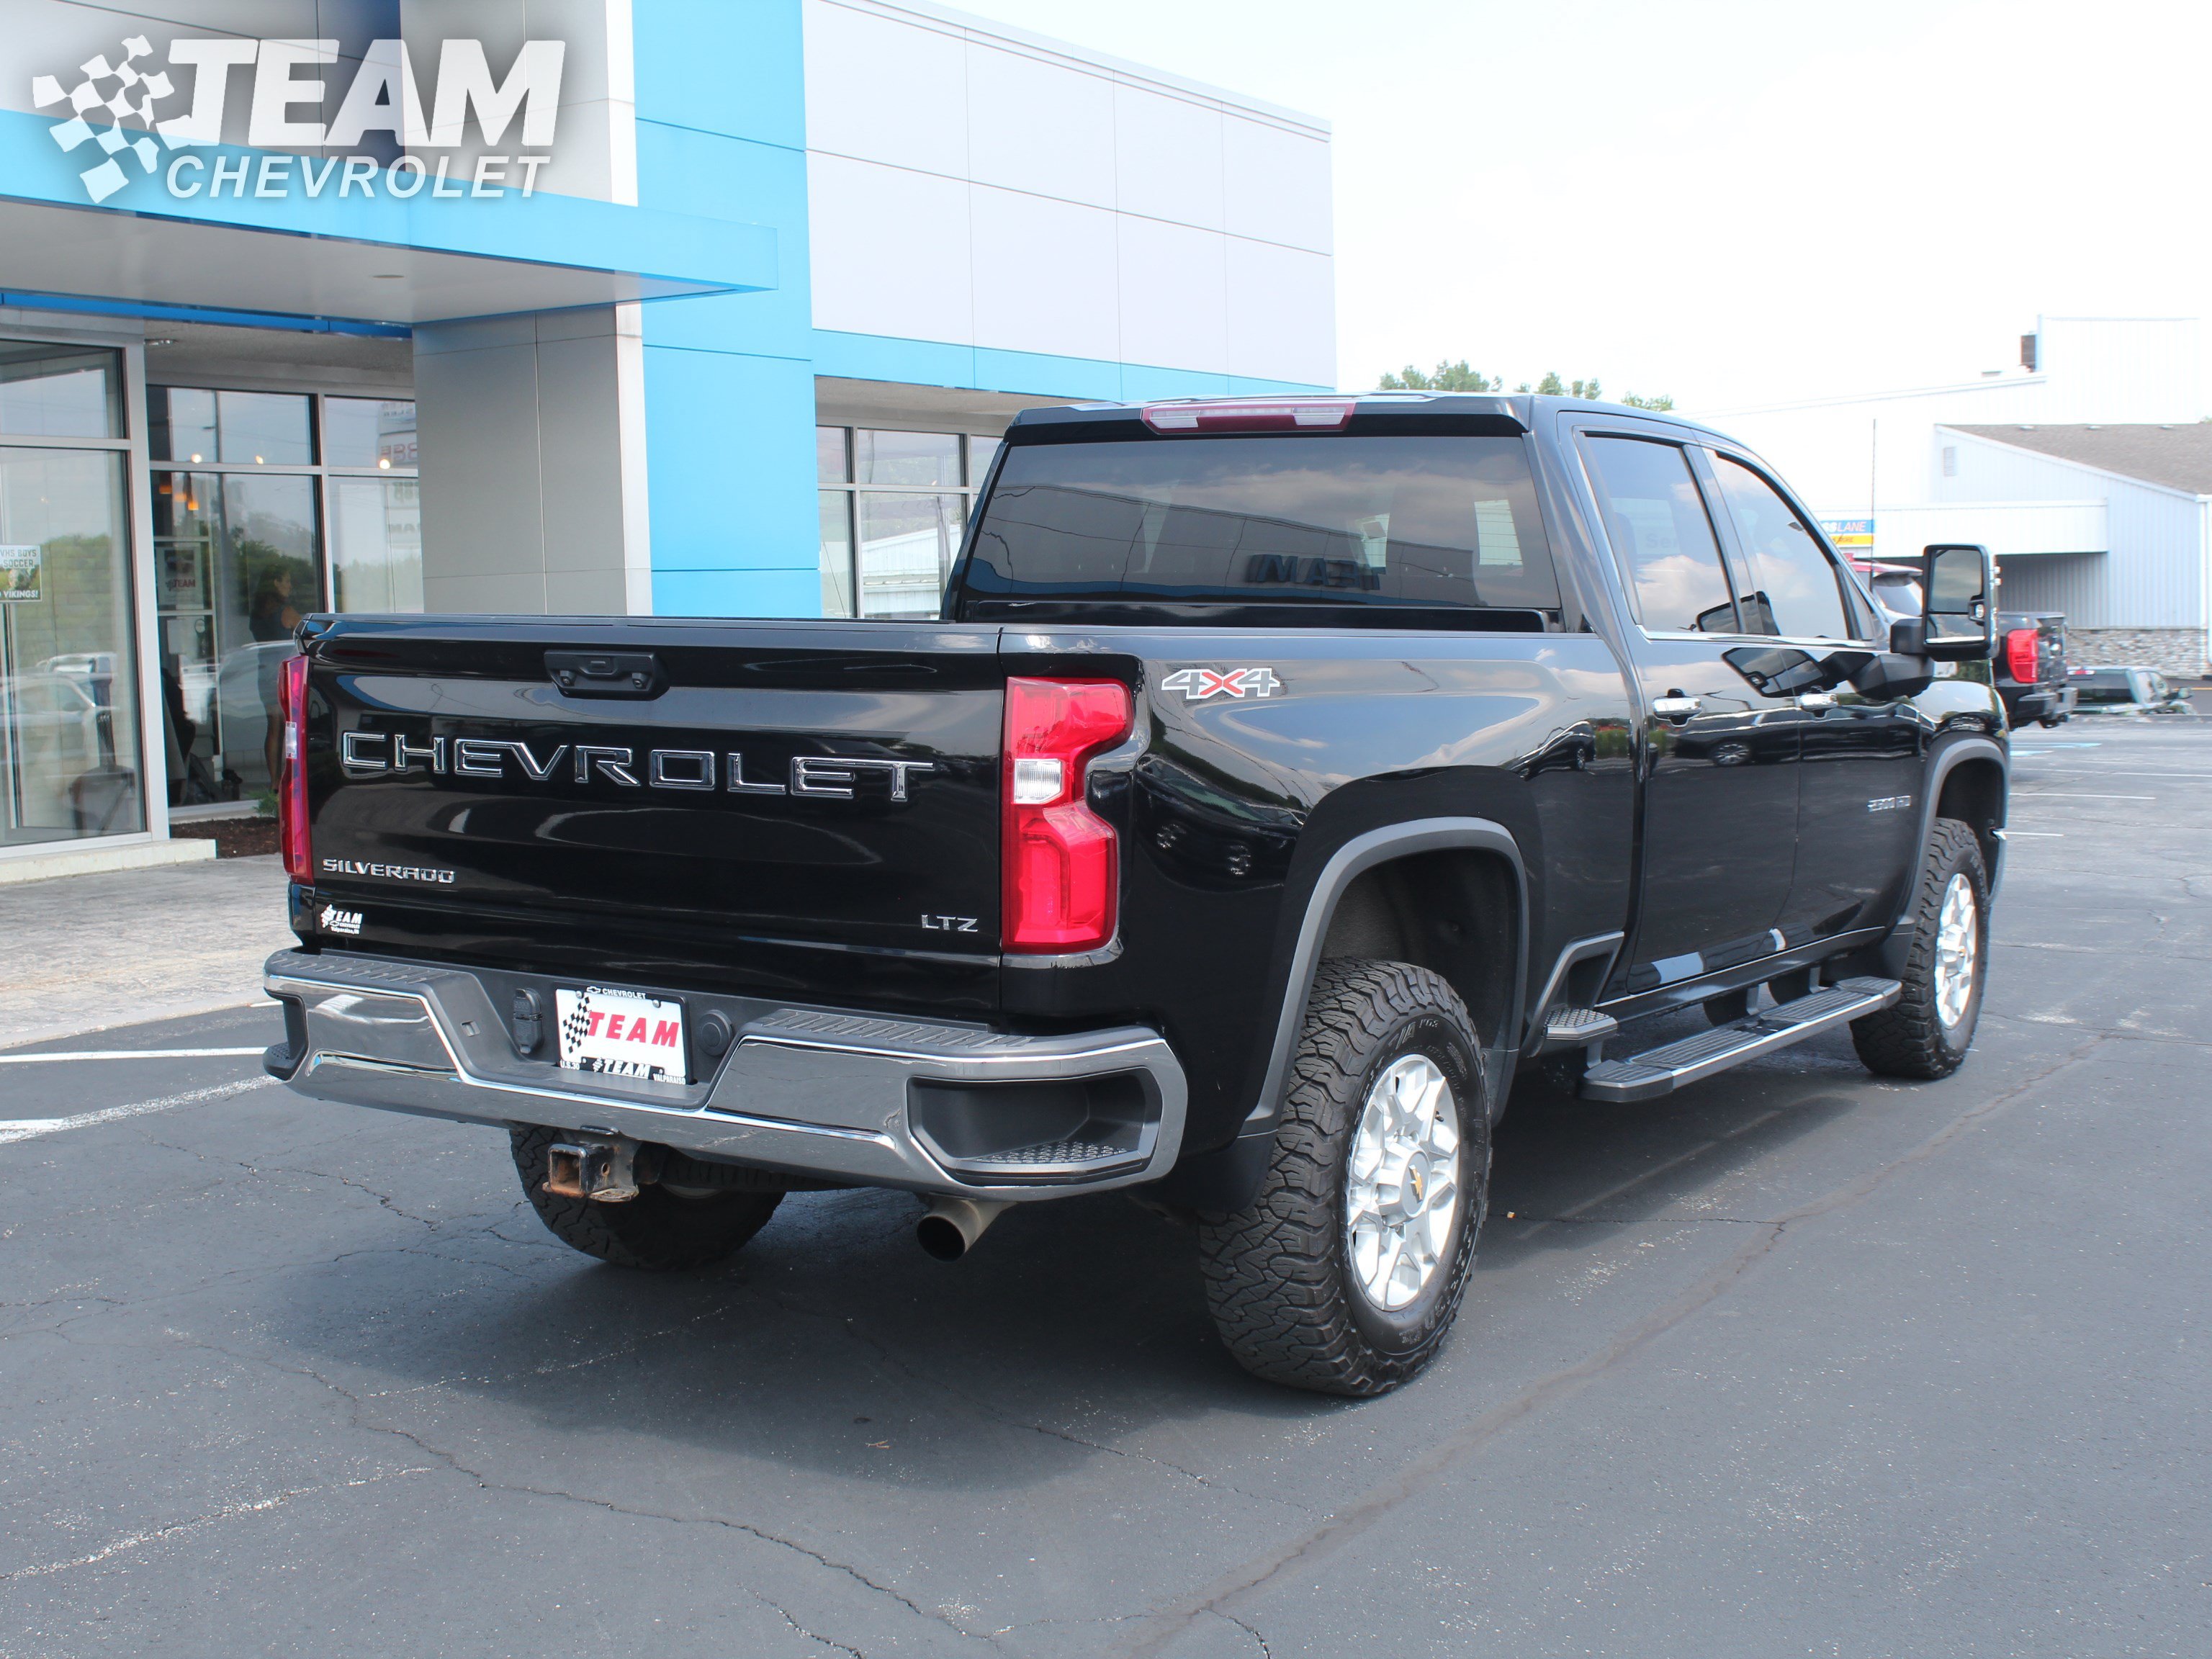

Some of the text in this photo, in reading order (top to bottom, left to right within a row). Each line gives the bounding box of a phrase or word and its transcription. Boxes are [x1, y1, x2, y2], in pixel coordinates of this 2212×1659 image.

[4, 590, 39, 598] VIKINGS!
[342, 731, 935, 802] CHEVROLET
[323, 858, 455, 884] SILVERADO
[922, 914, 978, 932] LTZ
[602, 988, 647, 999] CHEVROLET
[588, 1011, 679, 1048] TEAM
[603, 1058, 652, 1077] TEAM
[652, 1073, 686, 1085] VALPARAISO
